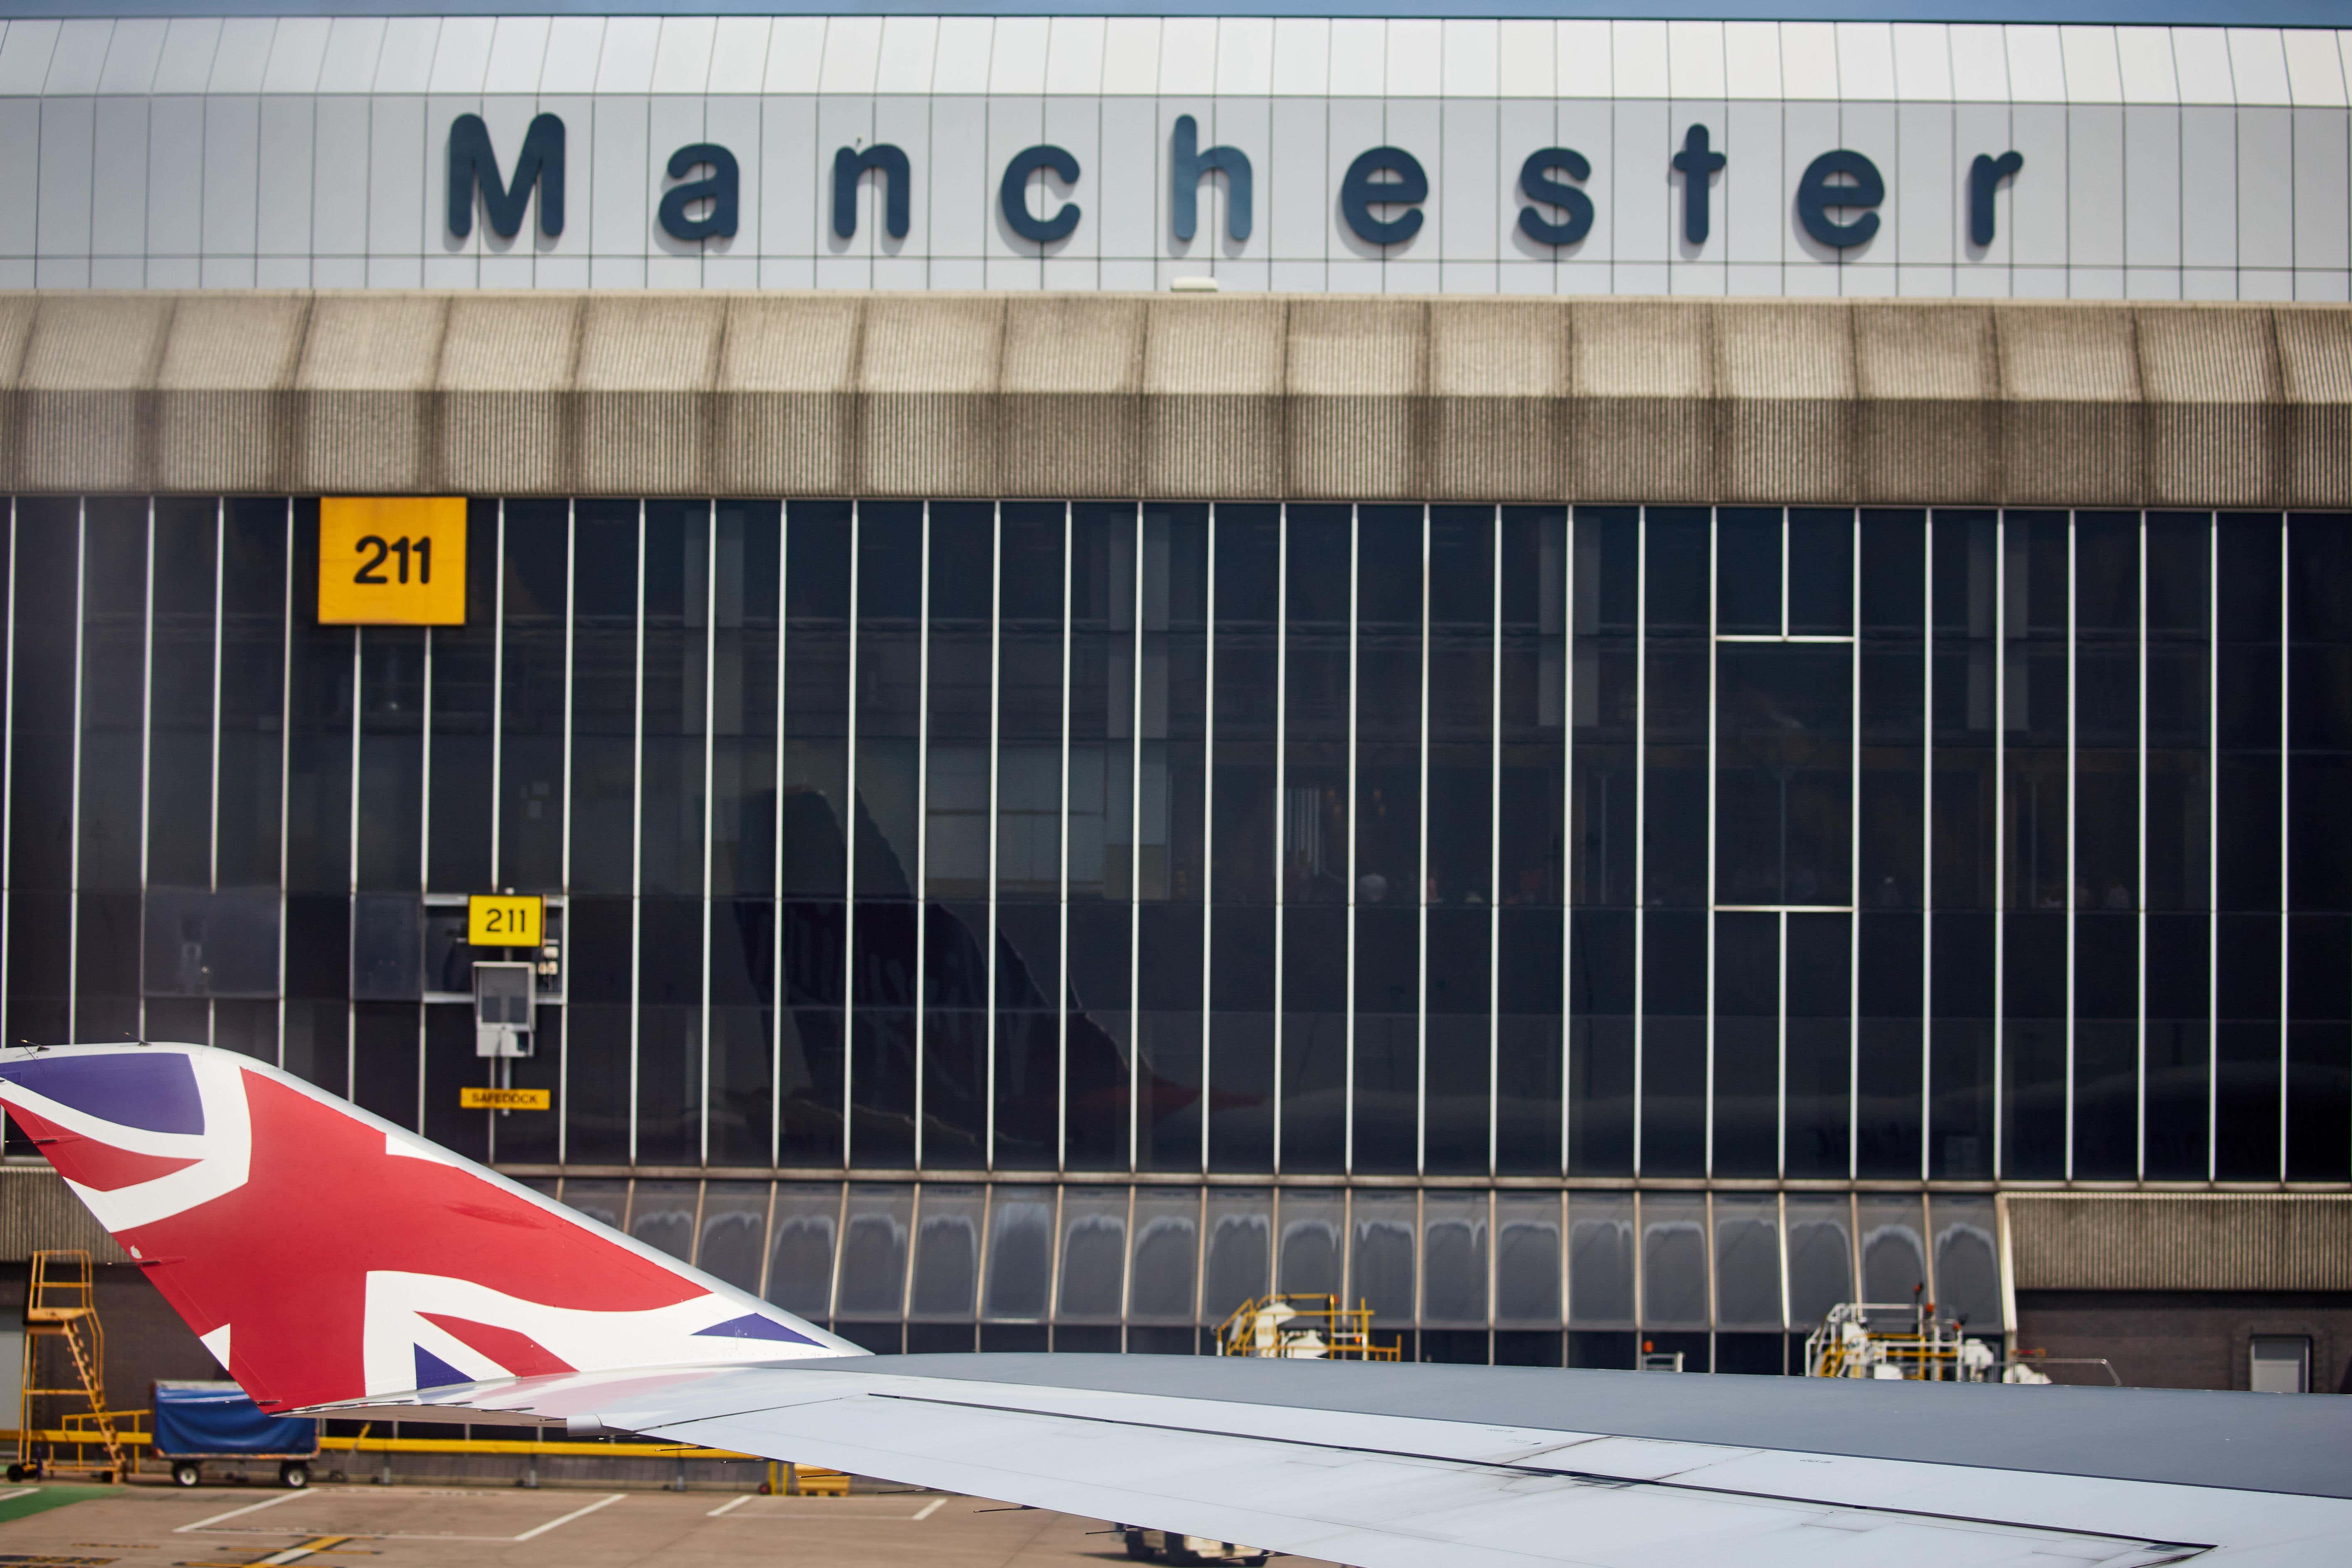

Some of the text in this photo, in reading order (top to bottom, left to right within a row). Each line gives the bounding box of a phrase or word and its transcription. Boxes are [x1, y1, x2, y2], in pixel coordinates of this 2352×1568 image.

[448, 113, 2024, 248] Manchester
[354, 535, 431, 584] 211
[486, 908, 525, 932] 211
[472, 1092, 537, 1104] SAFEDOCK
